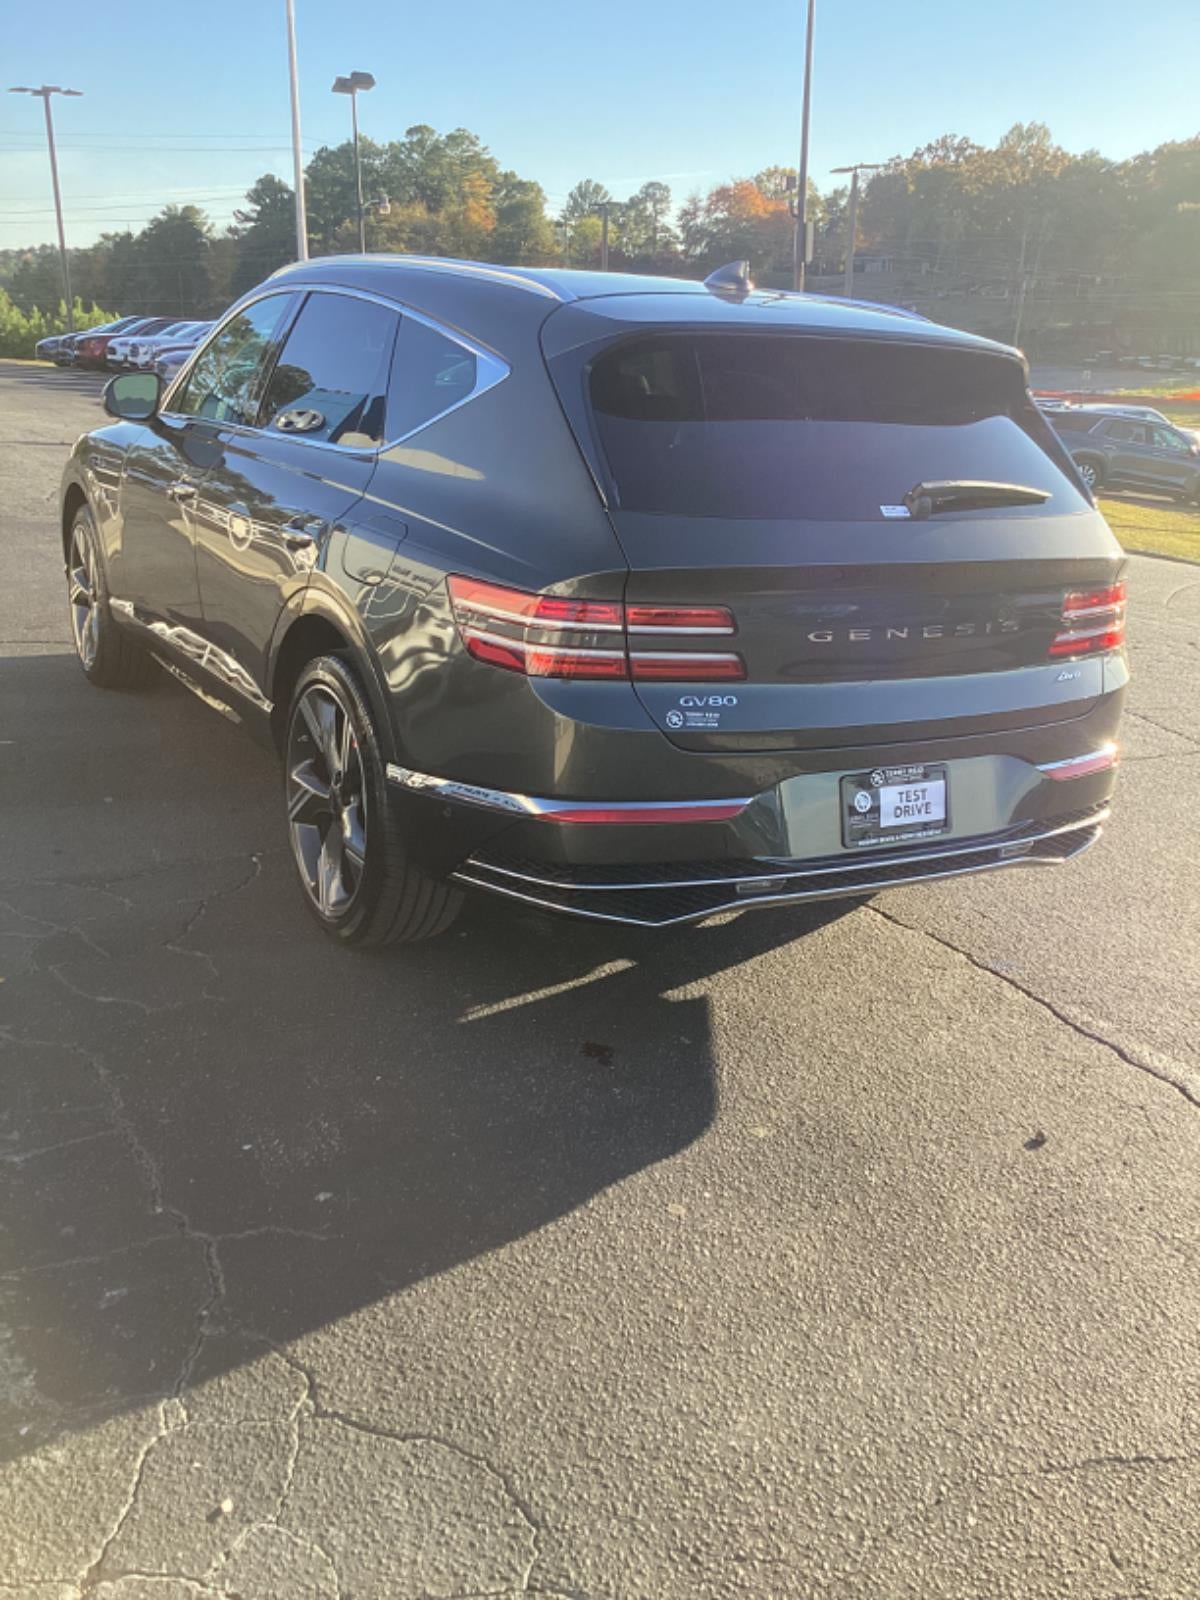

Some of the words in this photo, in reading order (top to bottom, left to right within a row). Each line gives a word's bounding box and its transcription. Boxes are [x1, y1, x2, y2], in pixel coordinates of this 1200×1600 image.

[808, 619, 1019, 643] GENESIS
[679, 695, 738, 707] GV80
[897, 788, 928, 804] TEST
[893, 802, 932, 818] DRIVE
